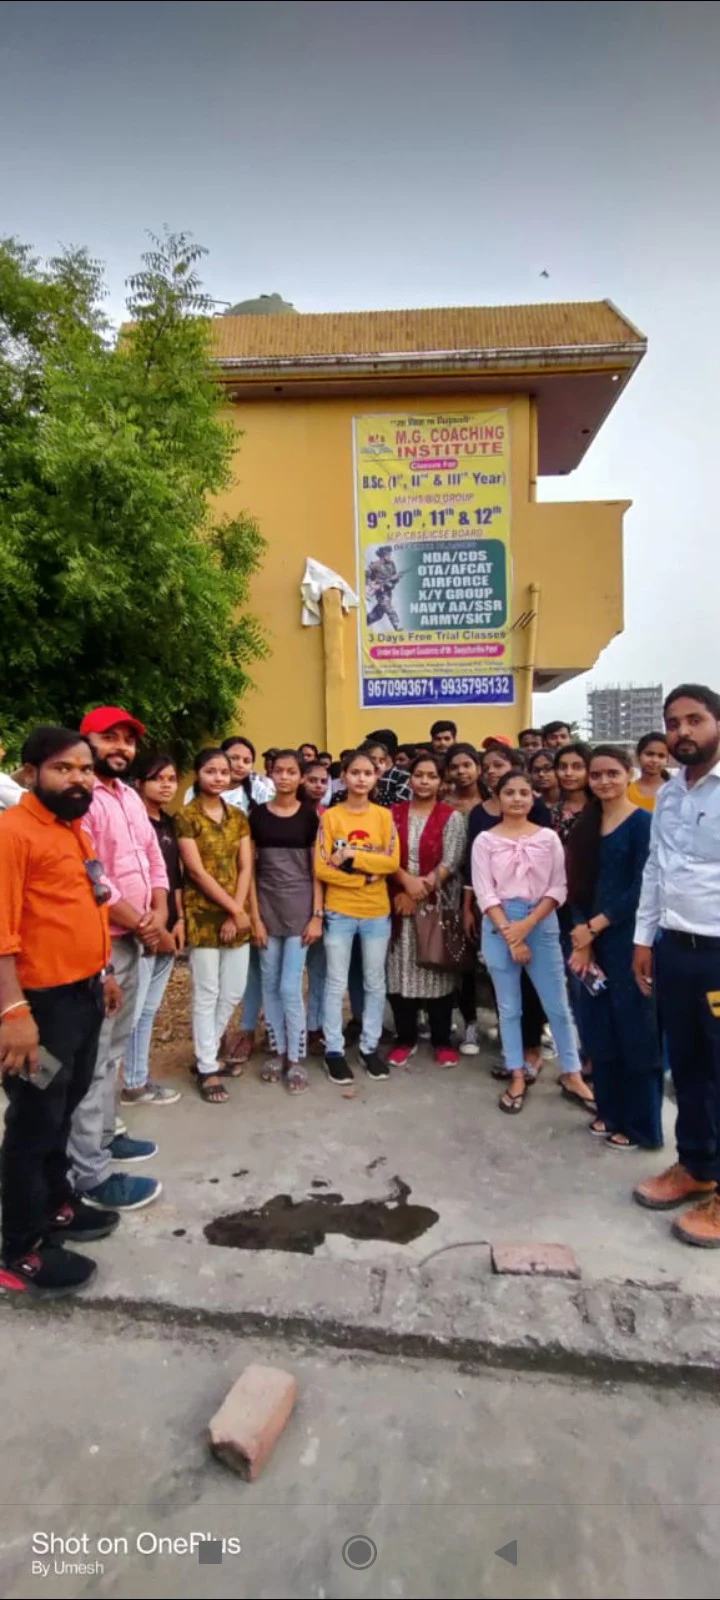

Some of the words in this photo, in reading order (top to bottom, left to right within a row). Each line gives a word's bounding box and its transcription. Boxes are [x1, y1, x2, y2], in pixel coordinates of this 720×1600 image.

[395, 429, 425, 444] M.G.
[430, 426, 504, 443] COACHING
[397, 442, 503, 457] INSTITUTE
[433, 474, 442, 486] &
[472, 471, 506, 486] Year)
[442, 492, 474, 502] GROUP
[430, 507, 454, 526] 11th
[459, 511, 470, 525] &
[475, 505, 502, 525] 12th
[423, 551, 487, 563] NDA/CDS
[417, 563, 494, 576] OTA/AFCAT
[422, 575, 489, 588] AIRFORCE
[418, 589, 445, 601] X/Y
[446, 588, 493, 600] GROUP
[410, 601, 448, 613] NAVY
[449, 600, 502, 612] AA/SSR
[420, 613, 492, 626] ARMY/SKT
[369, 634, 374, 642] 3
[377, 633, 405, 644] Days
[408, 632, 432, 641] Free
[436, 631, 459, 640] Trial
[462, 630, 506, 639] Classes
[367, 679, 438, 699] 9670993671,
[441, 677, 509, 695] 9935795132
